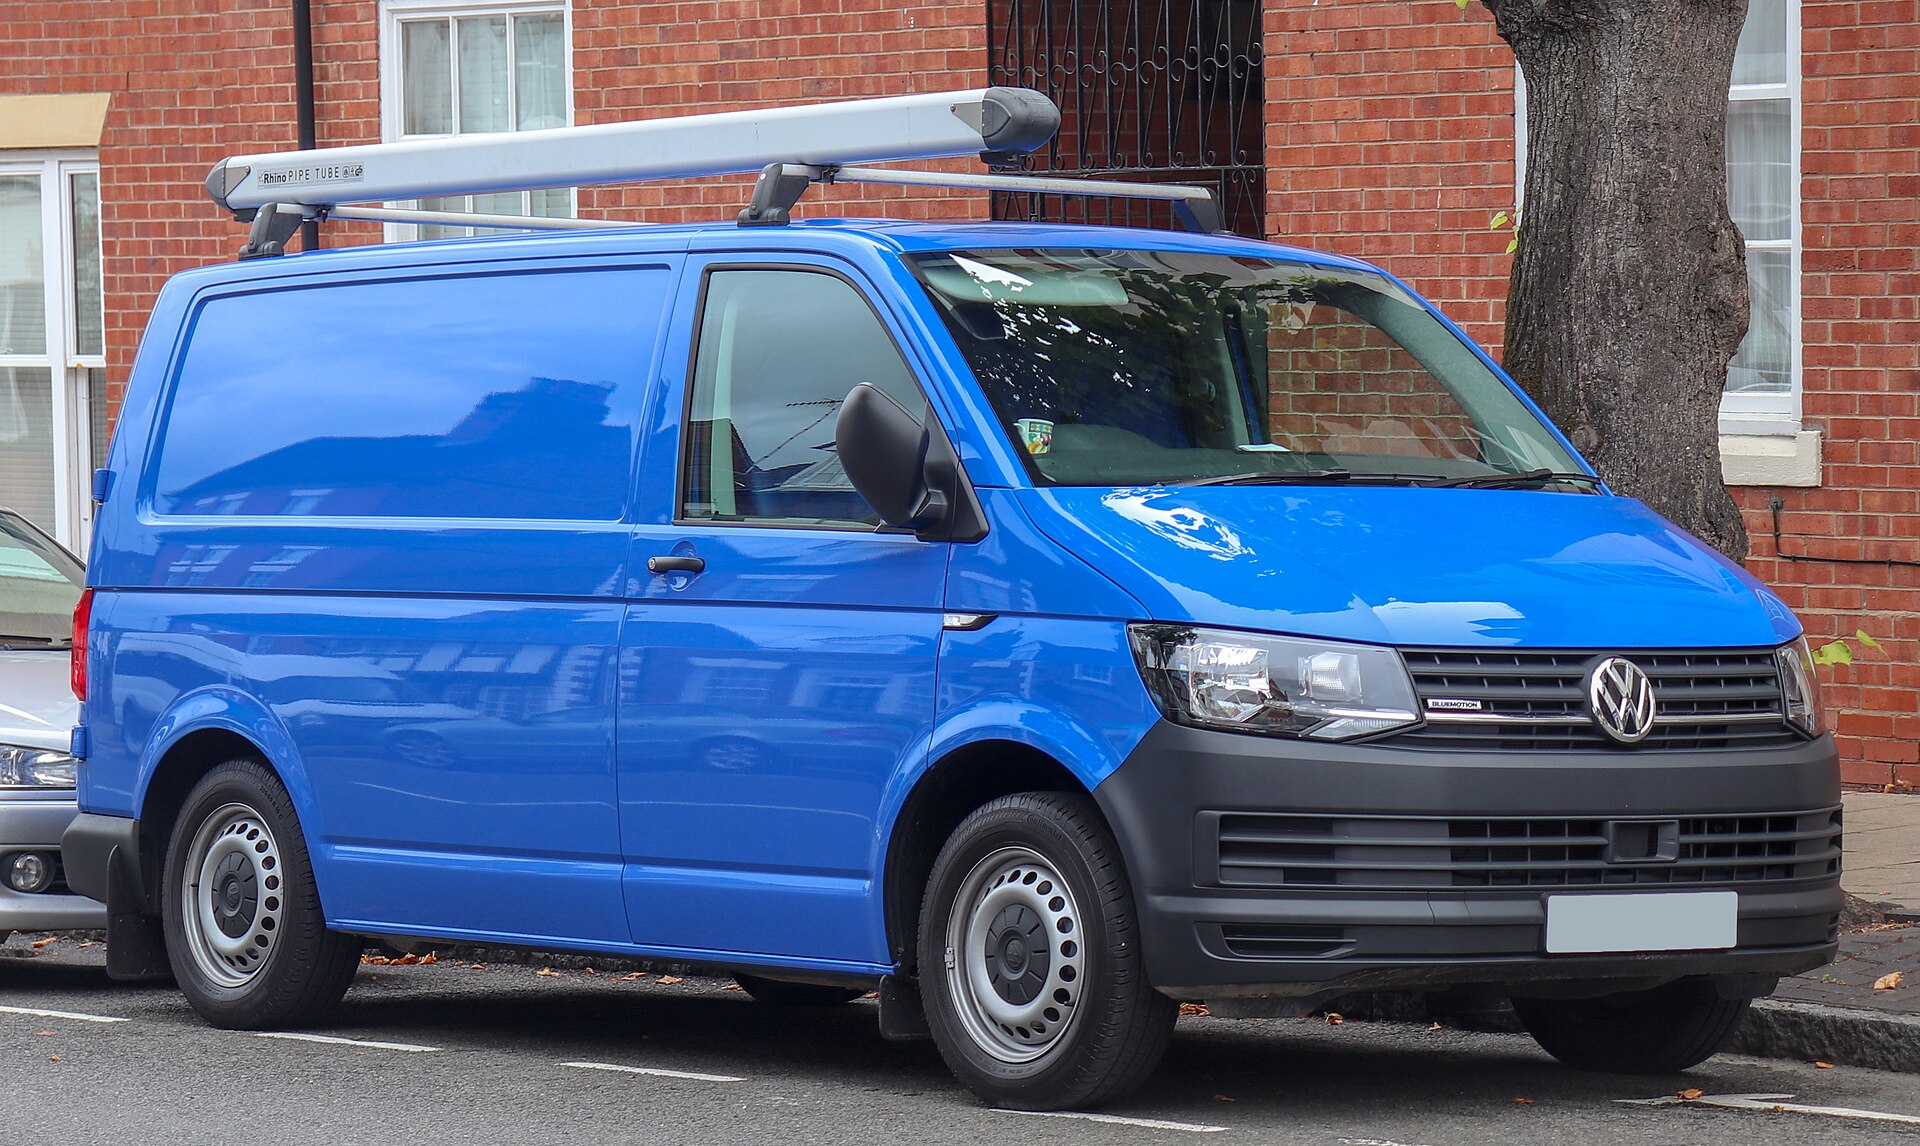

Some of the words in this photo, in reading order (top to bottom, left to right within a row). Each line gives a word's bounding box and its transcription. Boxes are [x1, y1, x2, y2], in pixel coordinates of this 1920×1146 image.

[263, 172, 287, 184] Rhino
[288, 169, 310, 181] PIPE
[315, 166, 340, 179] TUBE
